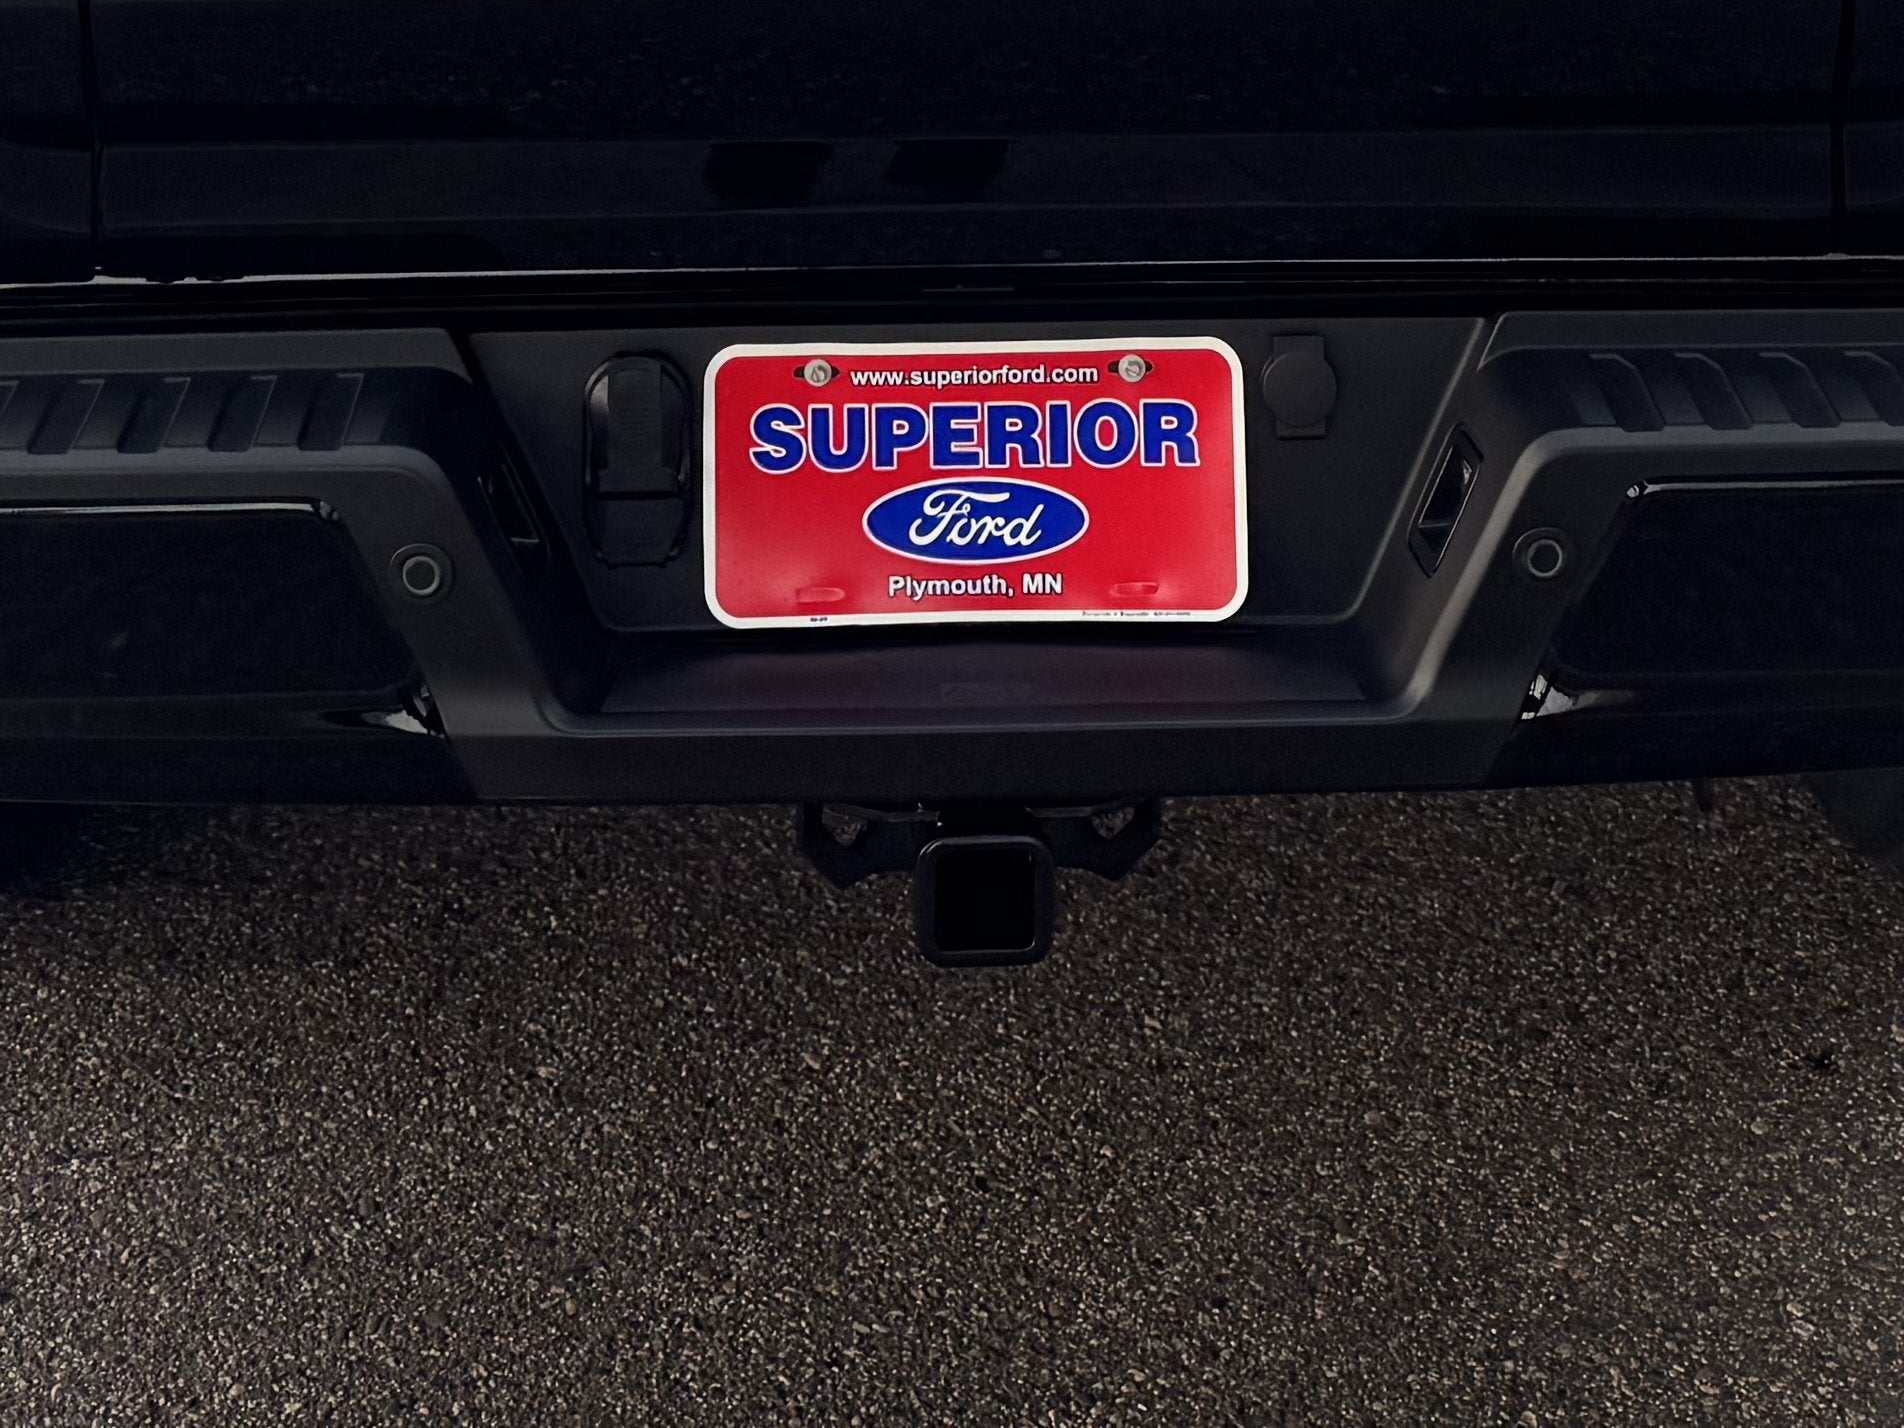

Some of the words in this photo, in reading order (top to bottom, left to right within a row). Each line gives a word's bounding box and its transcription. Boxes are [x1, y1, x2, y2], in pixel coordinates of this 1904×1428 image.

[850, 365, 1099, 389] www.superiorford.com
[750, 399, 1200, 474] SUPERIOR
[908, 489, 1042, 547] Ford
[888, 575, 1014, 601] Plymouth,
[1022, 573, 1063, 595] MN
